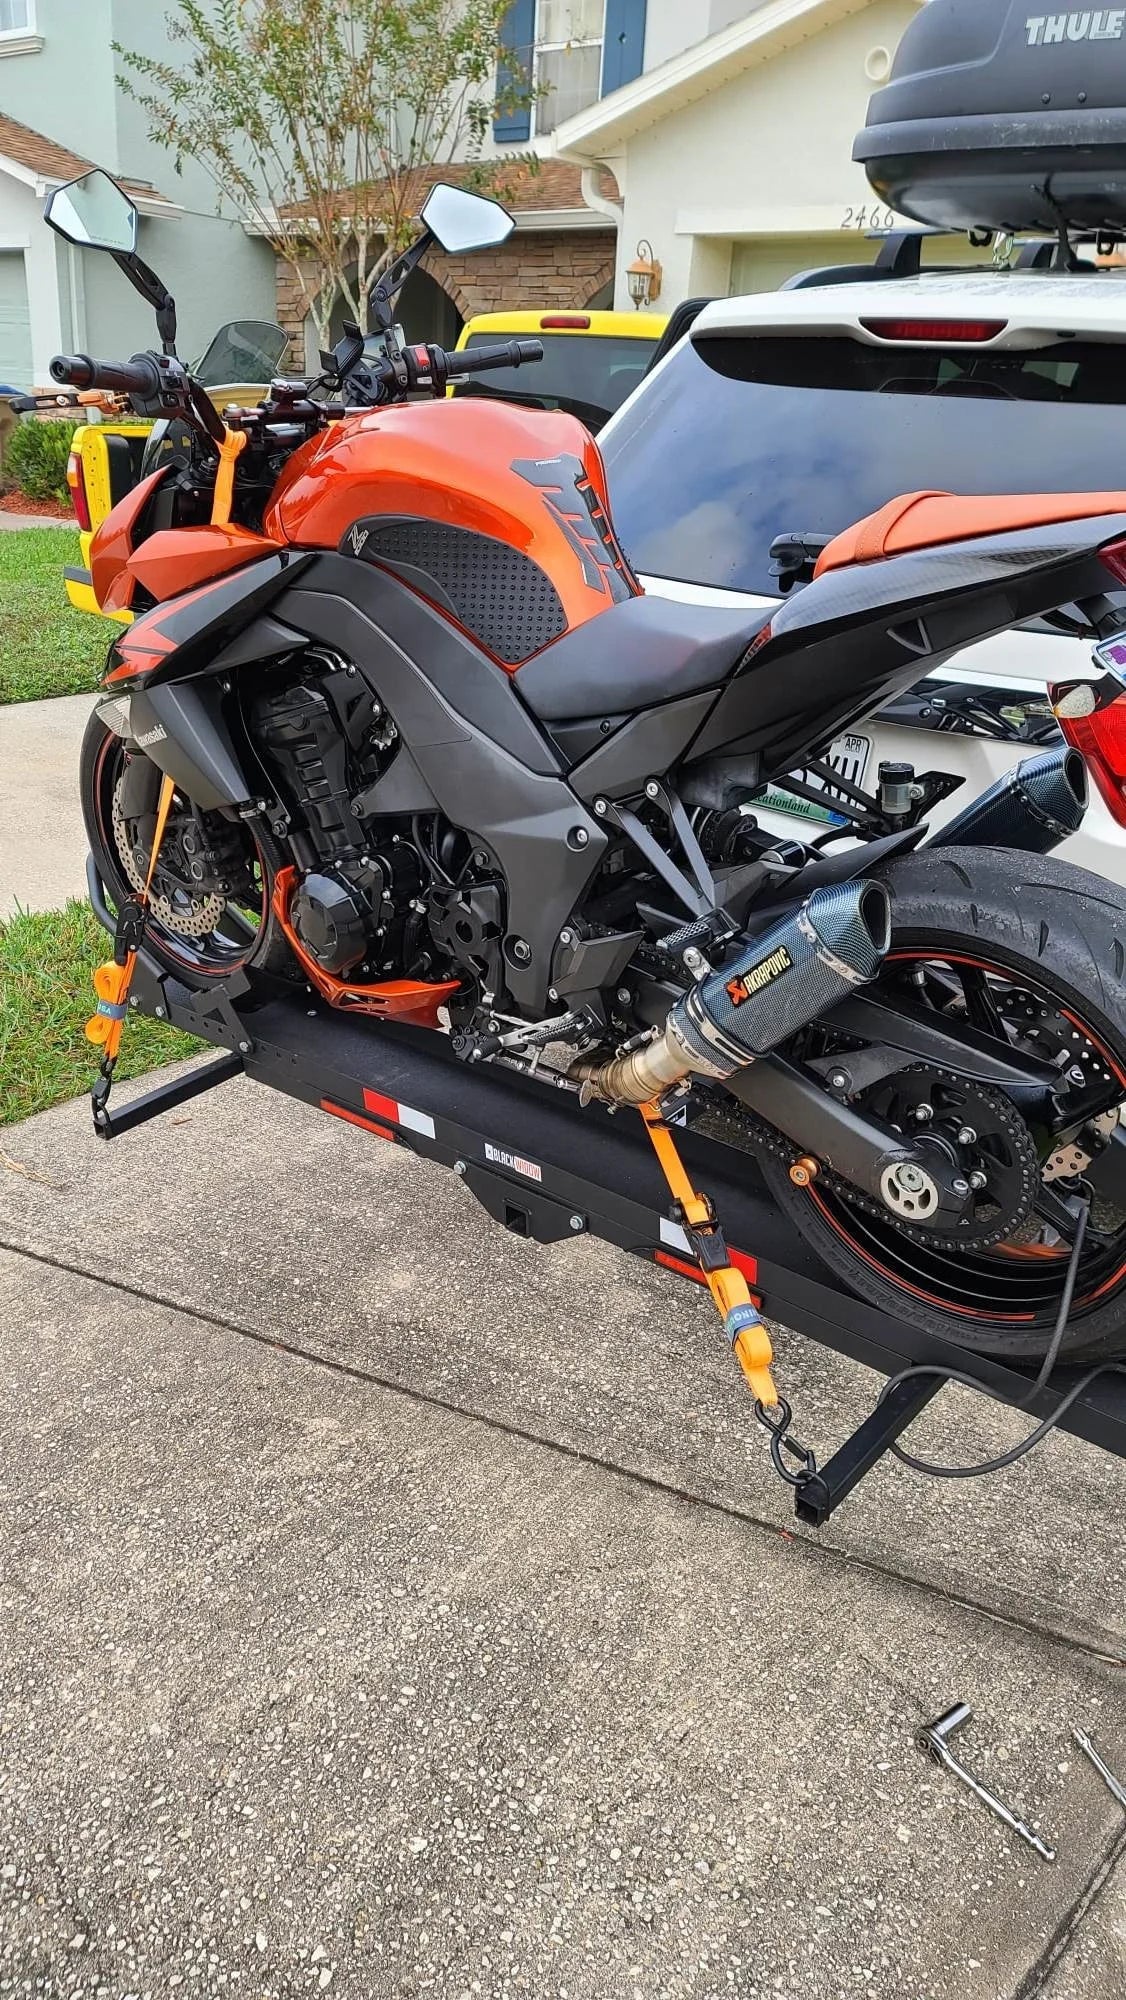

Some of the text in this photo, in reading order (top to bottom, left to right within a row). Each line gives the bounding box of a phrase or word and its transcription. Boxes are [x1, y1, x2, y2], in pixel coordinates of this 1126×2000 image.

[1025, 10, 1125, 46] THULE
[840, 205, 895, 230] 2466
[845, 738, 862, 750] APR
[756, 793, 811, 814] cationland
[493, 1148, 541, 1181] BLACK WIDOW
